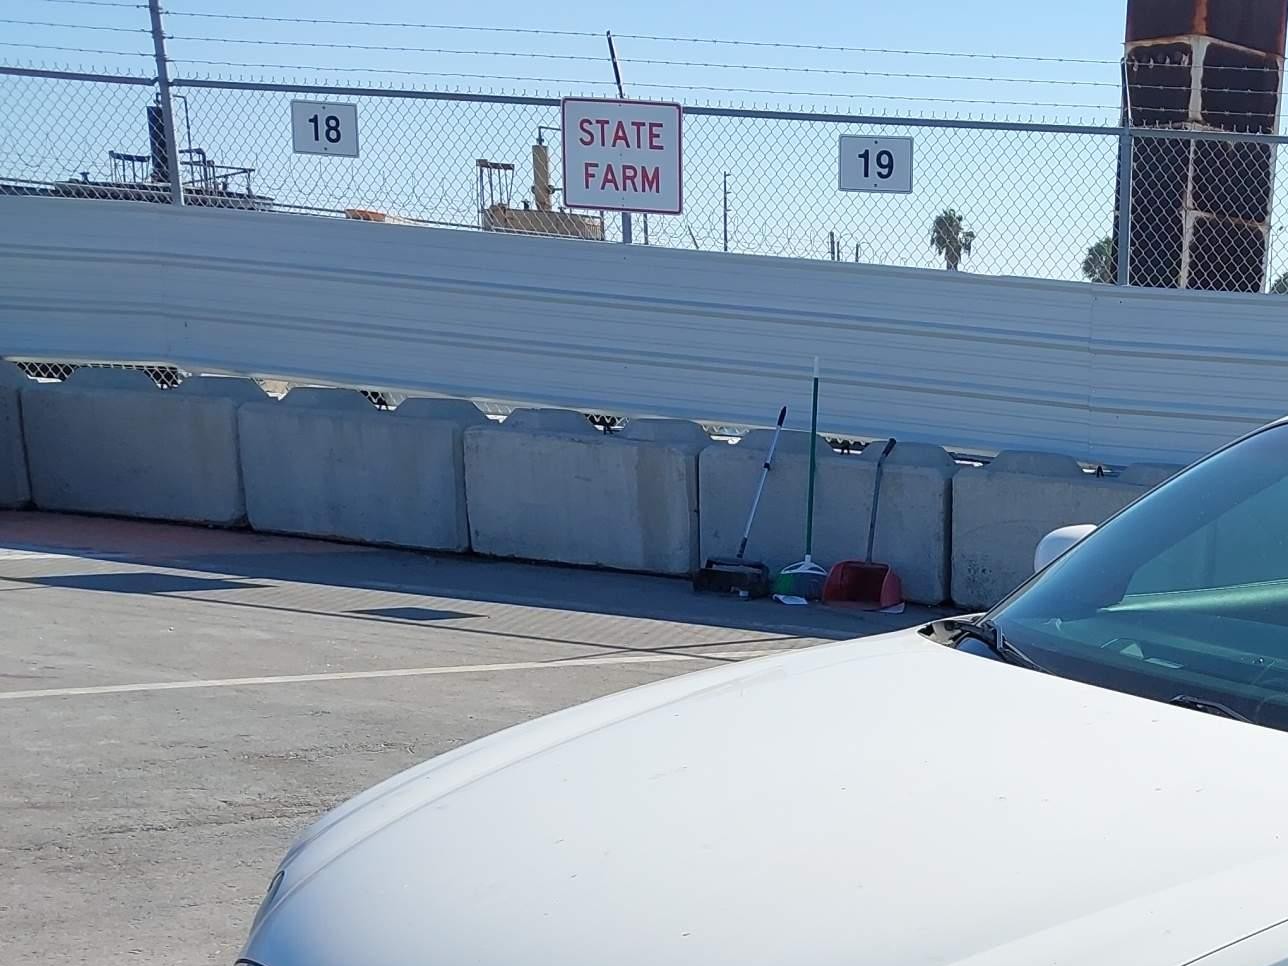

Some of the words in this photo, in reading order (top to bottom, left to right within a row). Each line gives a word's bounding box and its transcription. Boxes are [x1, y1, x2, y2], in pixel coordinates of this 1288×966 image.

[308, 114, 341, 143] 18
[579, 118, 665, 150] STATE
[584, 162, 660, 194] FARM
[858, 149, 894, 179] 19
